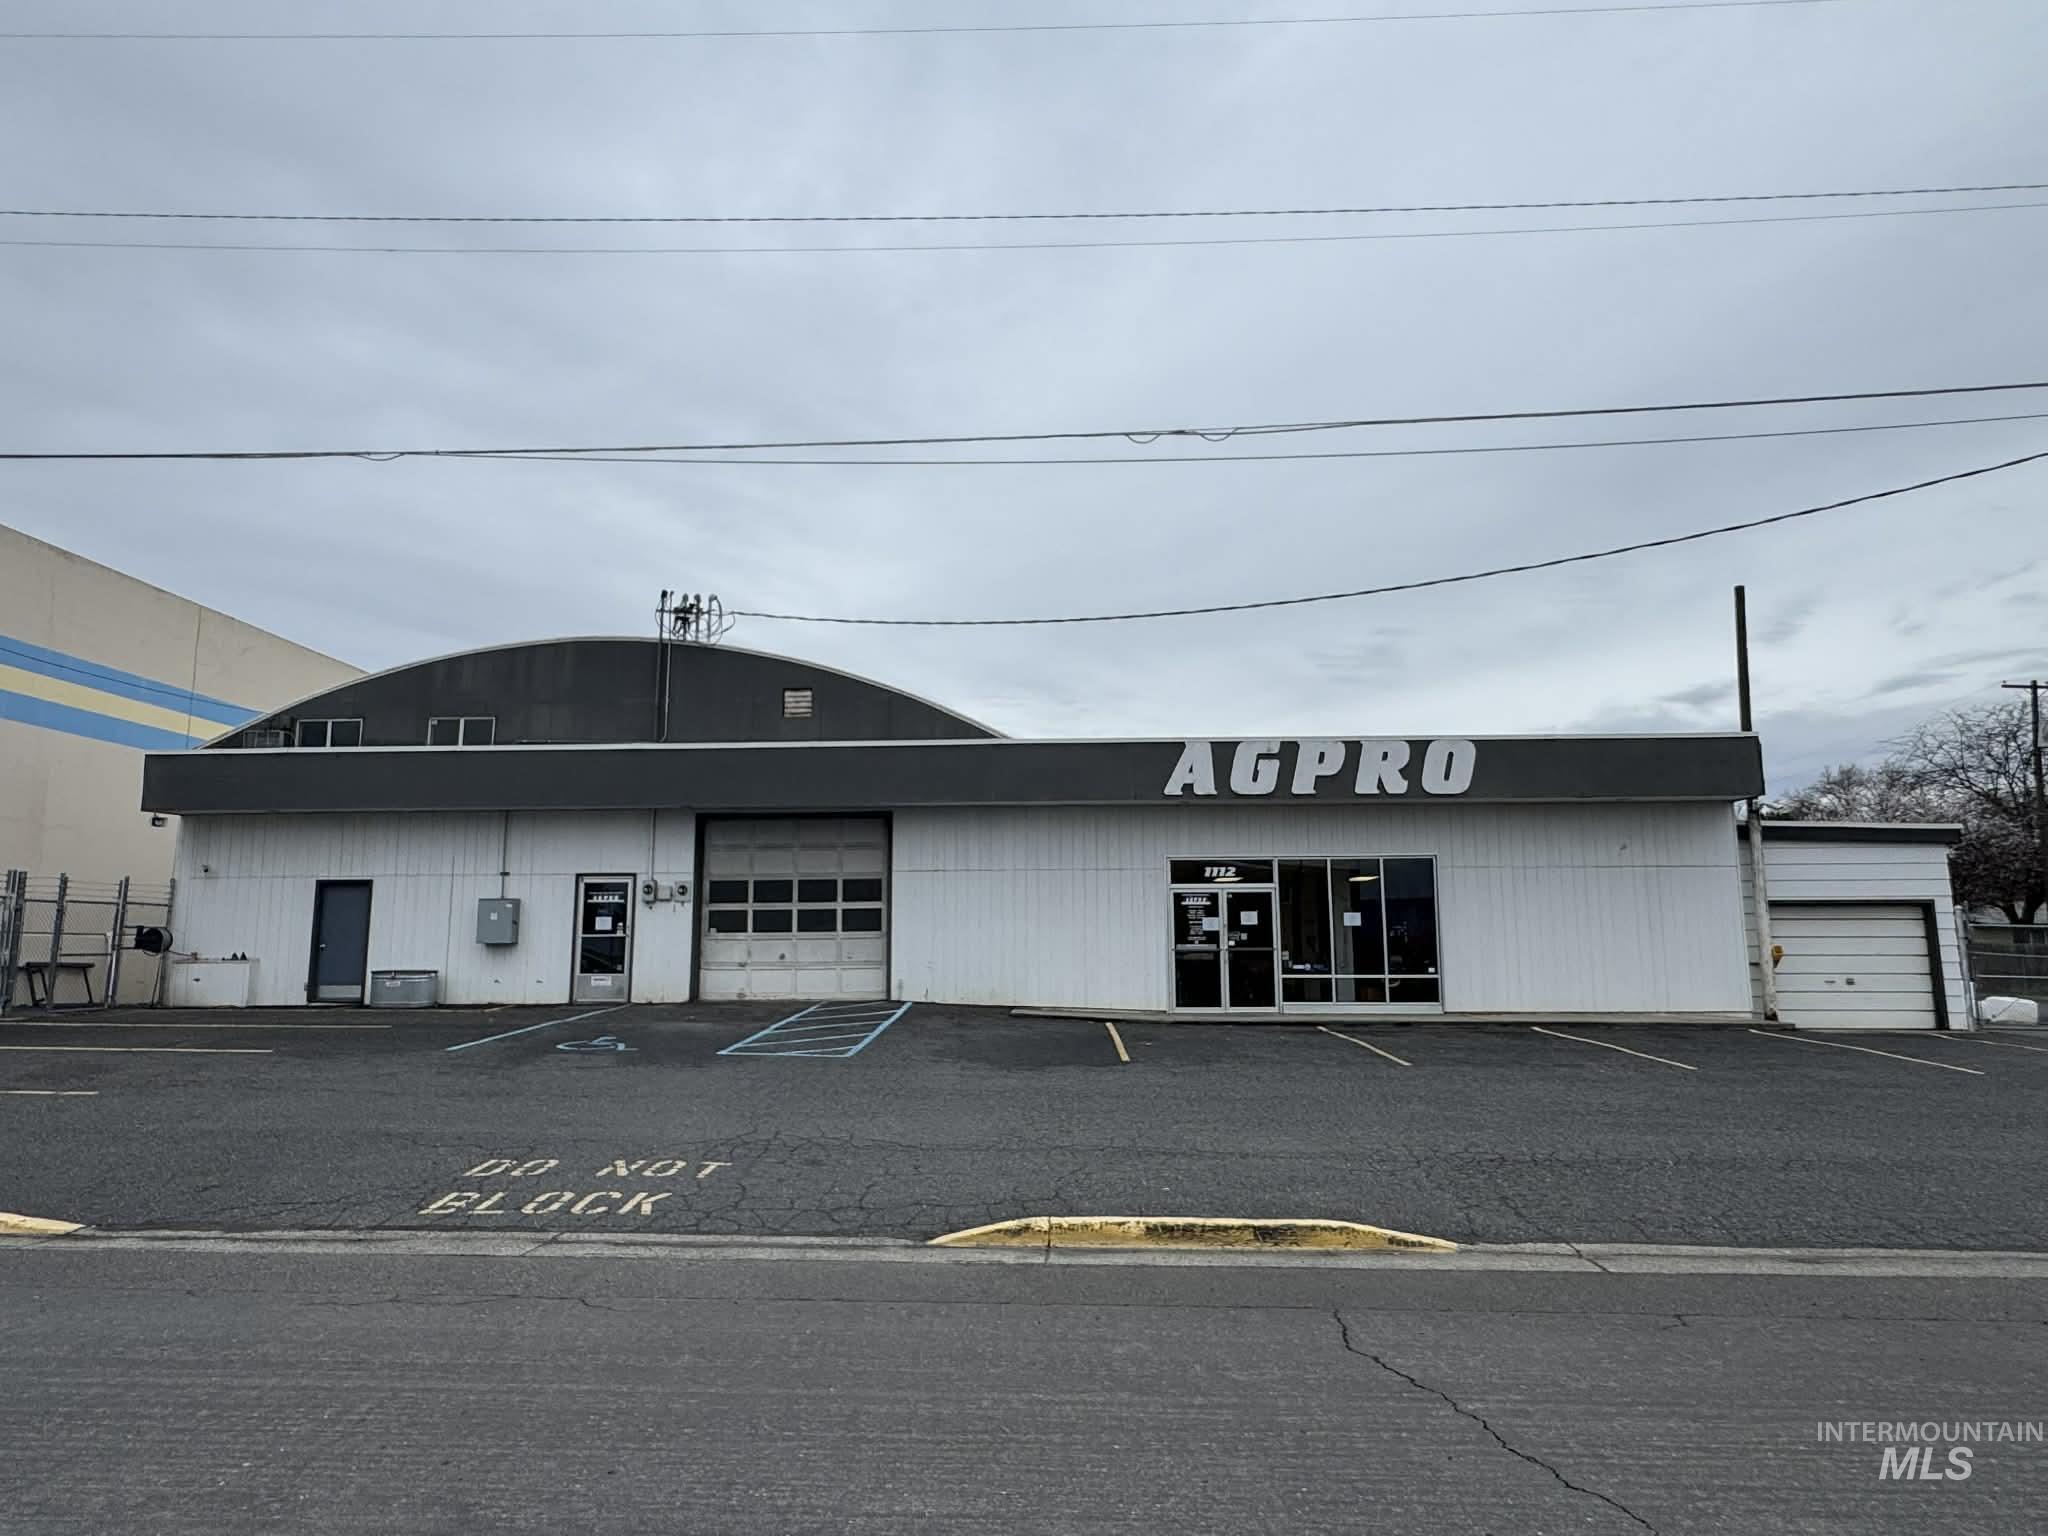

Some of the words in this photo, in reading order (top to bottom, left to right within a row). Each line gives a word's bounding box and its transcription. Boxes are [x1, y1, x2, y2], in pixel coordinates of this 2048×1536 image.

[1163, 739, 1476, 795] AGPRO
[1203, 866, 1236, 877] 1112
[462, 1159, 559, 1177] DO
[595, 1159, 733, 1178] NOT
[417, 1191, 673, 1215] BLOCK
